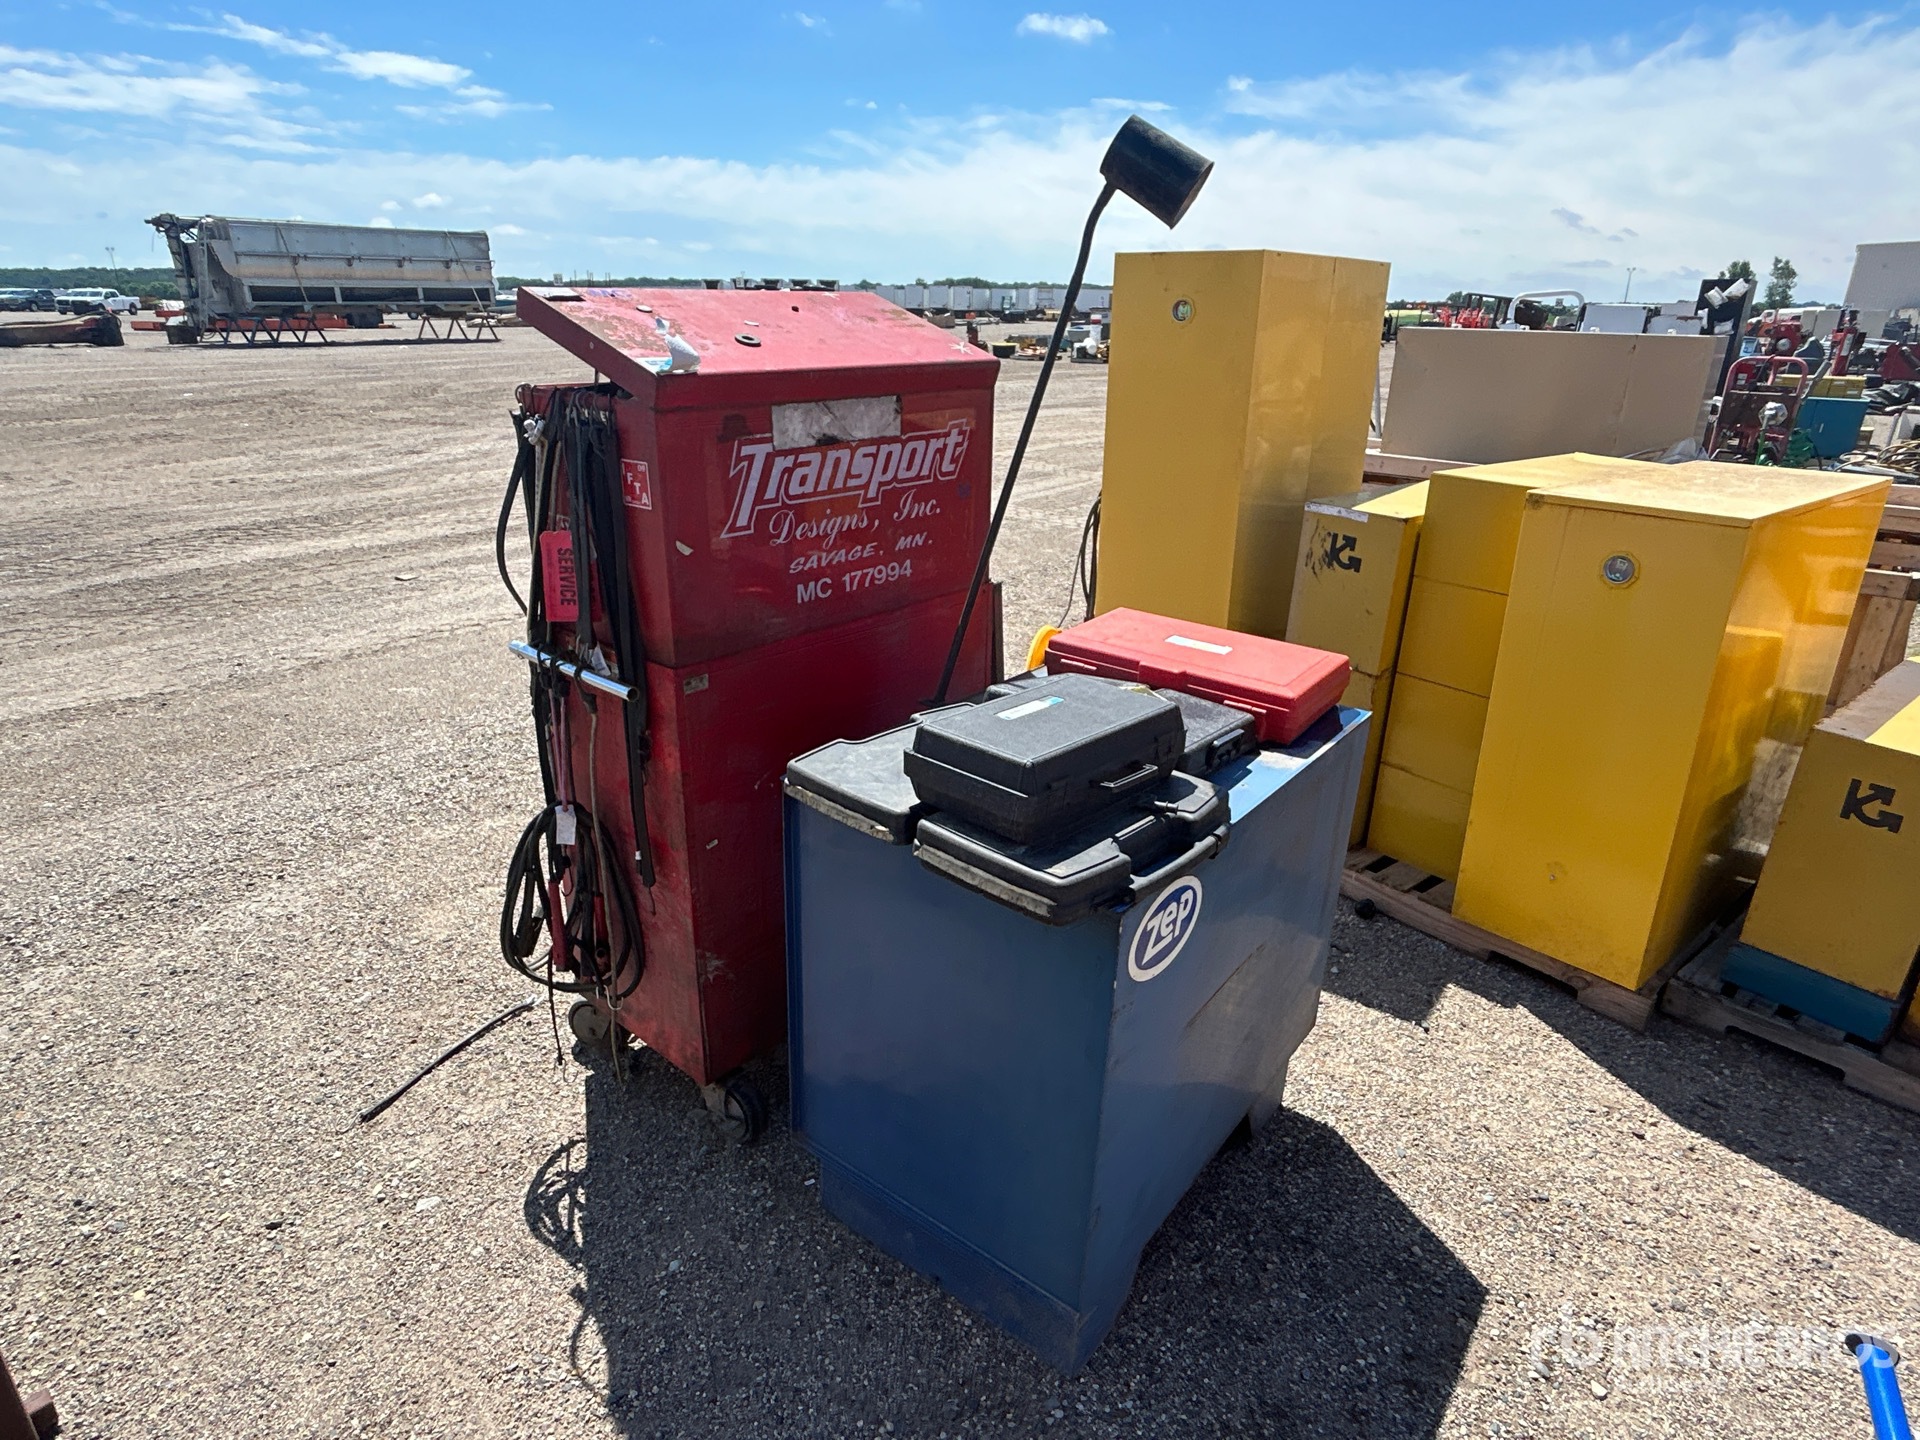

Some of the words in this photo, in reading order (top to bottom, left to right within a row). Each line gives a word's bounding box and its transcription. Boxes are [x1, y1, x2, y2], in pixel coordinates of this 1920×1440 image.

[726, 420, 970, 536] Transport
[769, 509, 880, 549] Designs,
[893, 489, 941, 521] Inc.
[895, 531, 934, 552] MN.
[557, 547, 577, 606] SERVICE
[796, 577, 832, 604] MC
[841, 559, 912, 592] 177994
